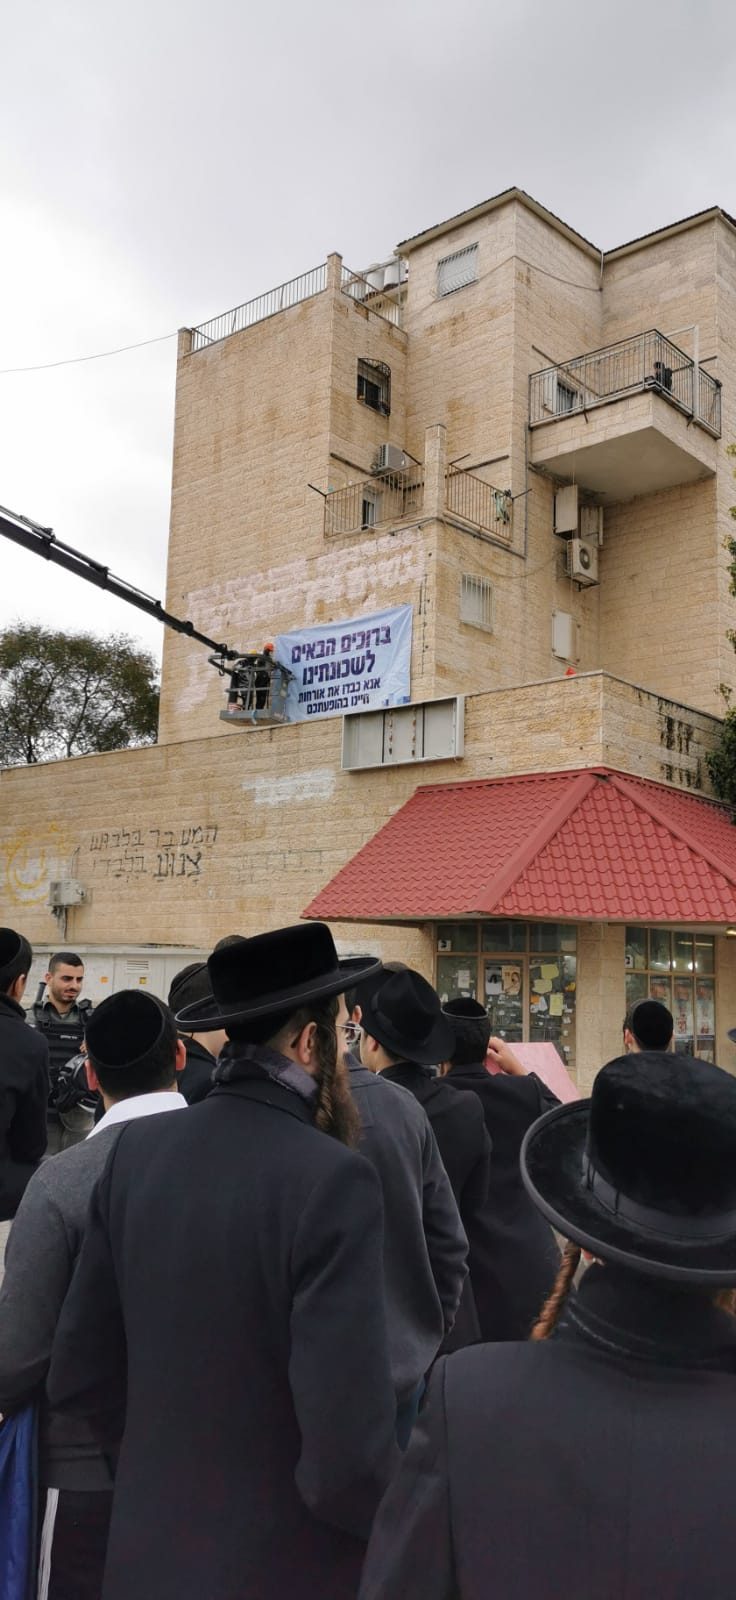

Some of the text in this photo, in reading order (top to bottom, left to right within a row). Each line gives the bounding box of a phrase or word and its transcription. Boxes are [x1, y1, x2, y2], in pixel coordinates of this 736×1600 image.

[292, 625, 391, 664] ברוכים הבאים
[303, 650, 375, 685] לשכונתינו
[298, 677, 381, 704] אנא כבדו את אורחות
[307, 697, 348, 714] בהופעתכם
